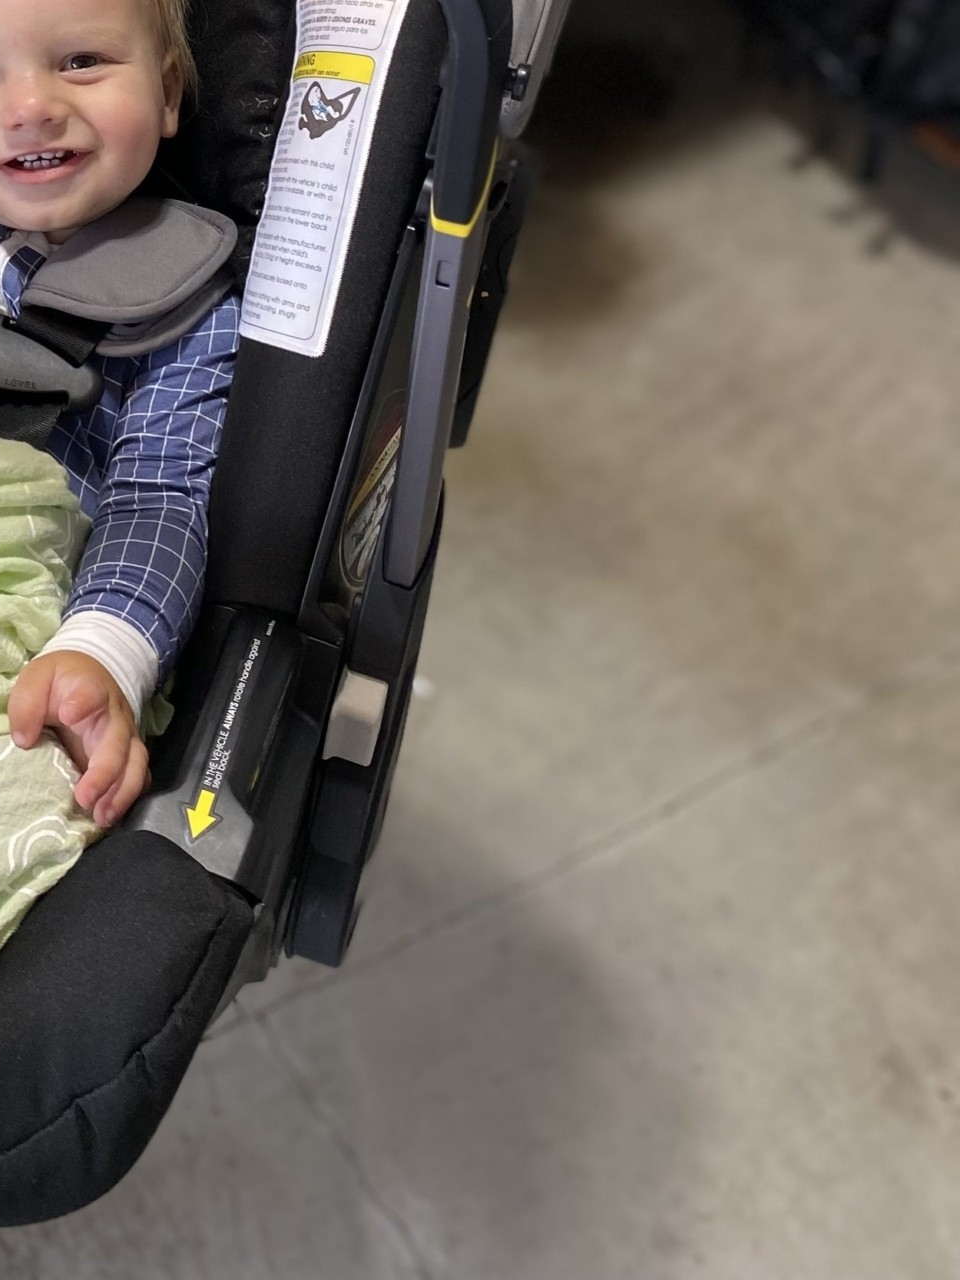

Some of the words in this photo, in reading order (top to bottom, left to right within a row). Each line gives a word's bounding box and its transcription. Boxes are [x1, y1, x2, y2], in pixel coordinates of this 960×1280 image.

[320, 182, 338, 192] child
[309, 221, 328, 231] back
[293, 260, 322, 272] exceeds
[4, 378, 39, 390] LEVEL
[246, 638, 263, 661] against
[238, 658, 254, 682] handle
[231, 681, 246, 703] rotate
[221, 700, 240, 730] ALWAYS
[205, 761, 218, 776] THE
[203, 775, 214, 786] IN
[210, 770, 224, 789] seat
